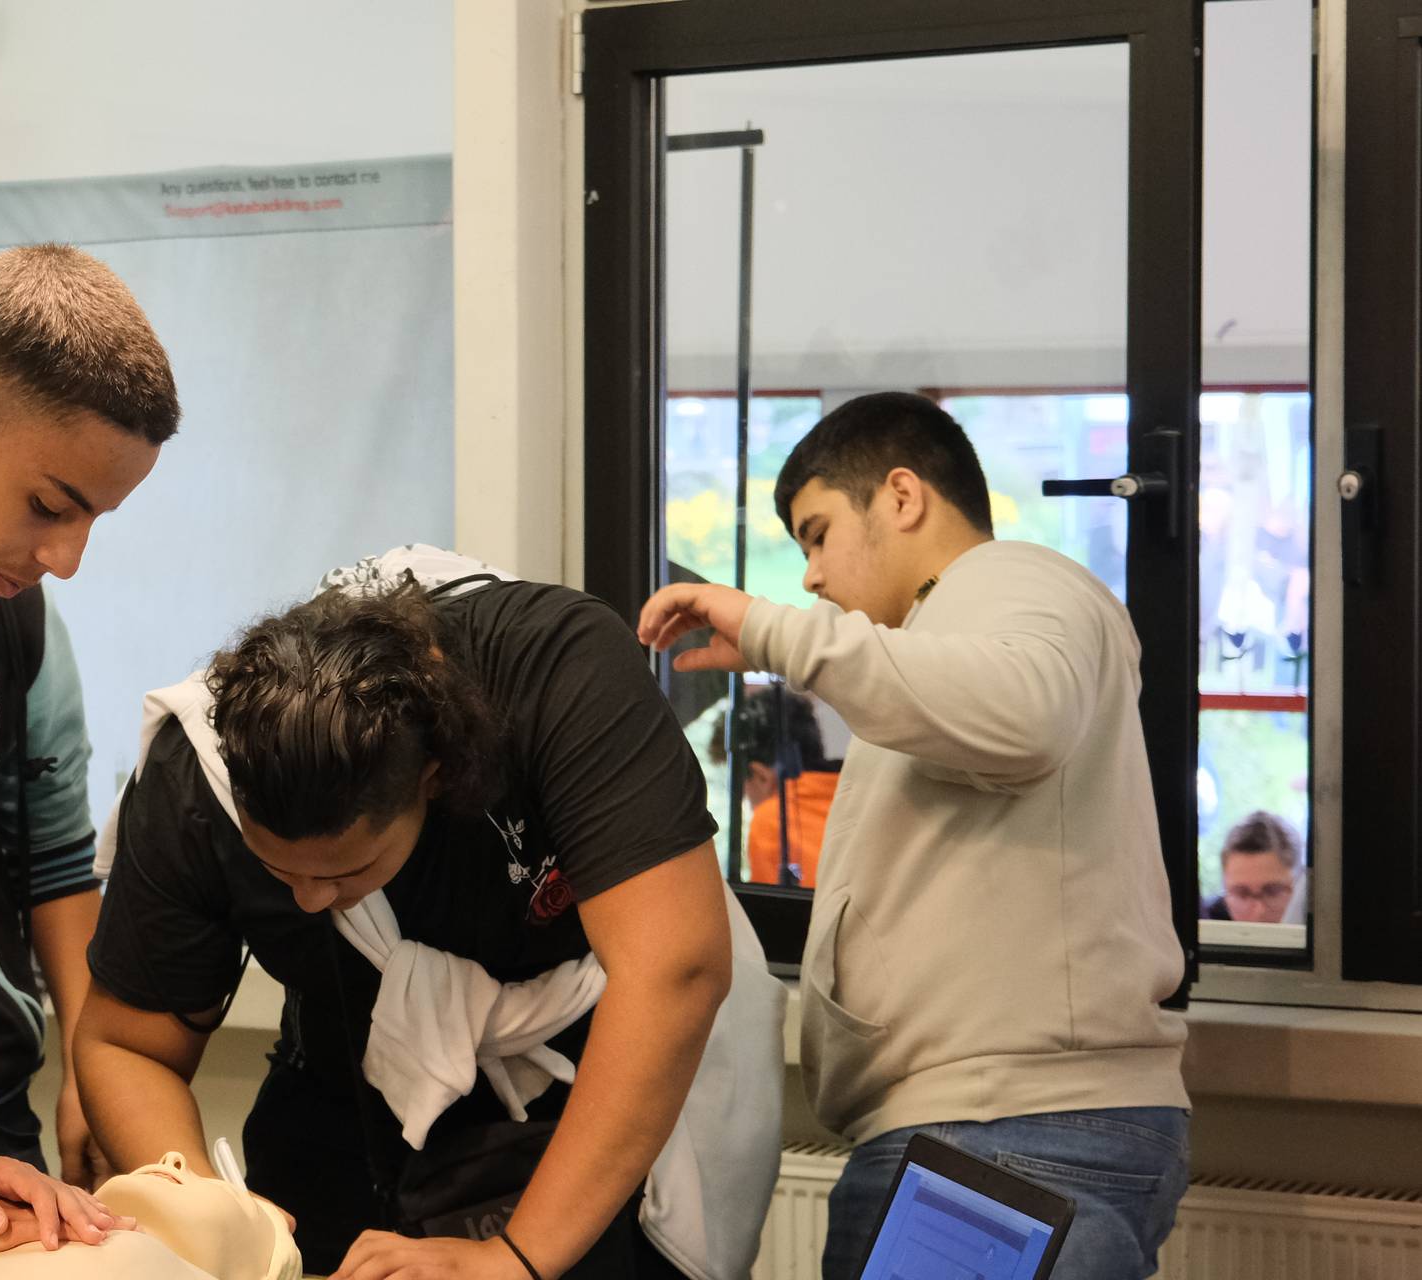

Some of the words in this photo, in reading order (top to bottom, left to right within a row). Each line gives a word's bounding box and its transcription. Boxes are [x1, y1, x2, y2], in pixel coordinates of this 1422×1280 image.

[161, 183, 182, 198] Any
[247, 174, 270, 191] feel
[271, 173, 296, 190] free
[298, 173, 313, 188] to
[313, 171, 357, 188] contact
[361, 171, 381, 184] me
